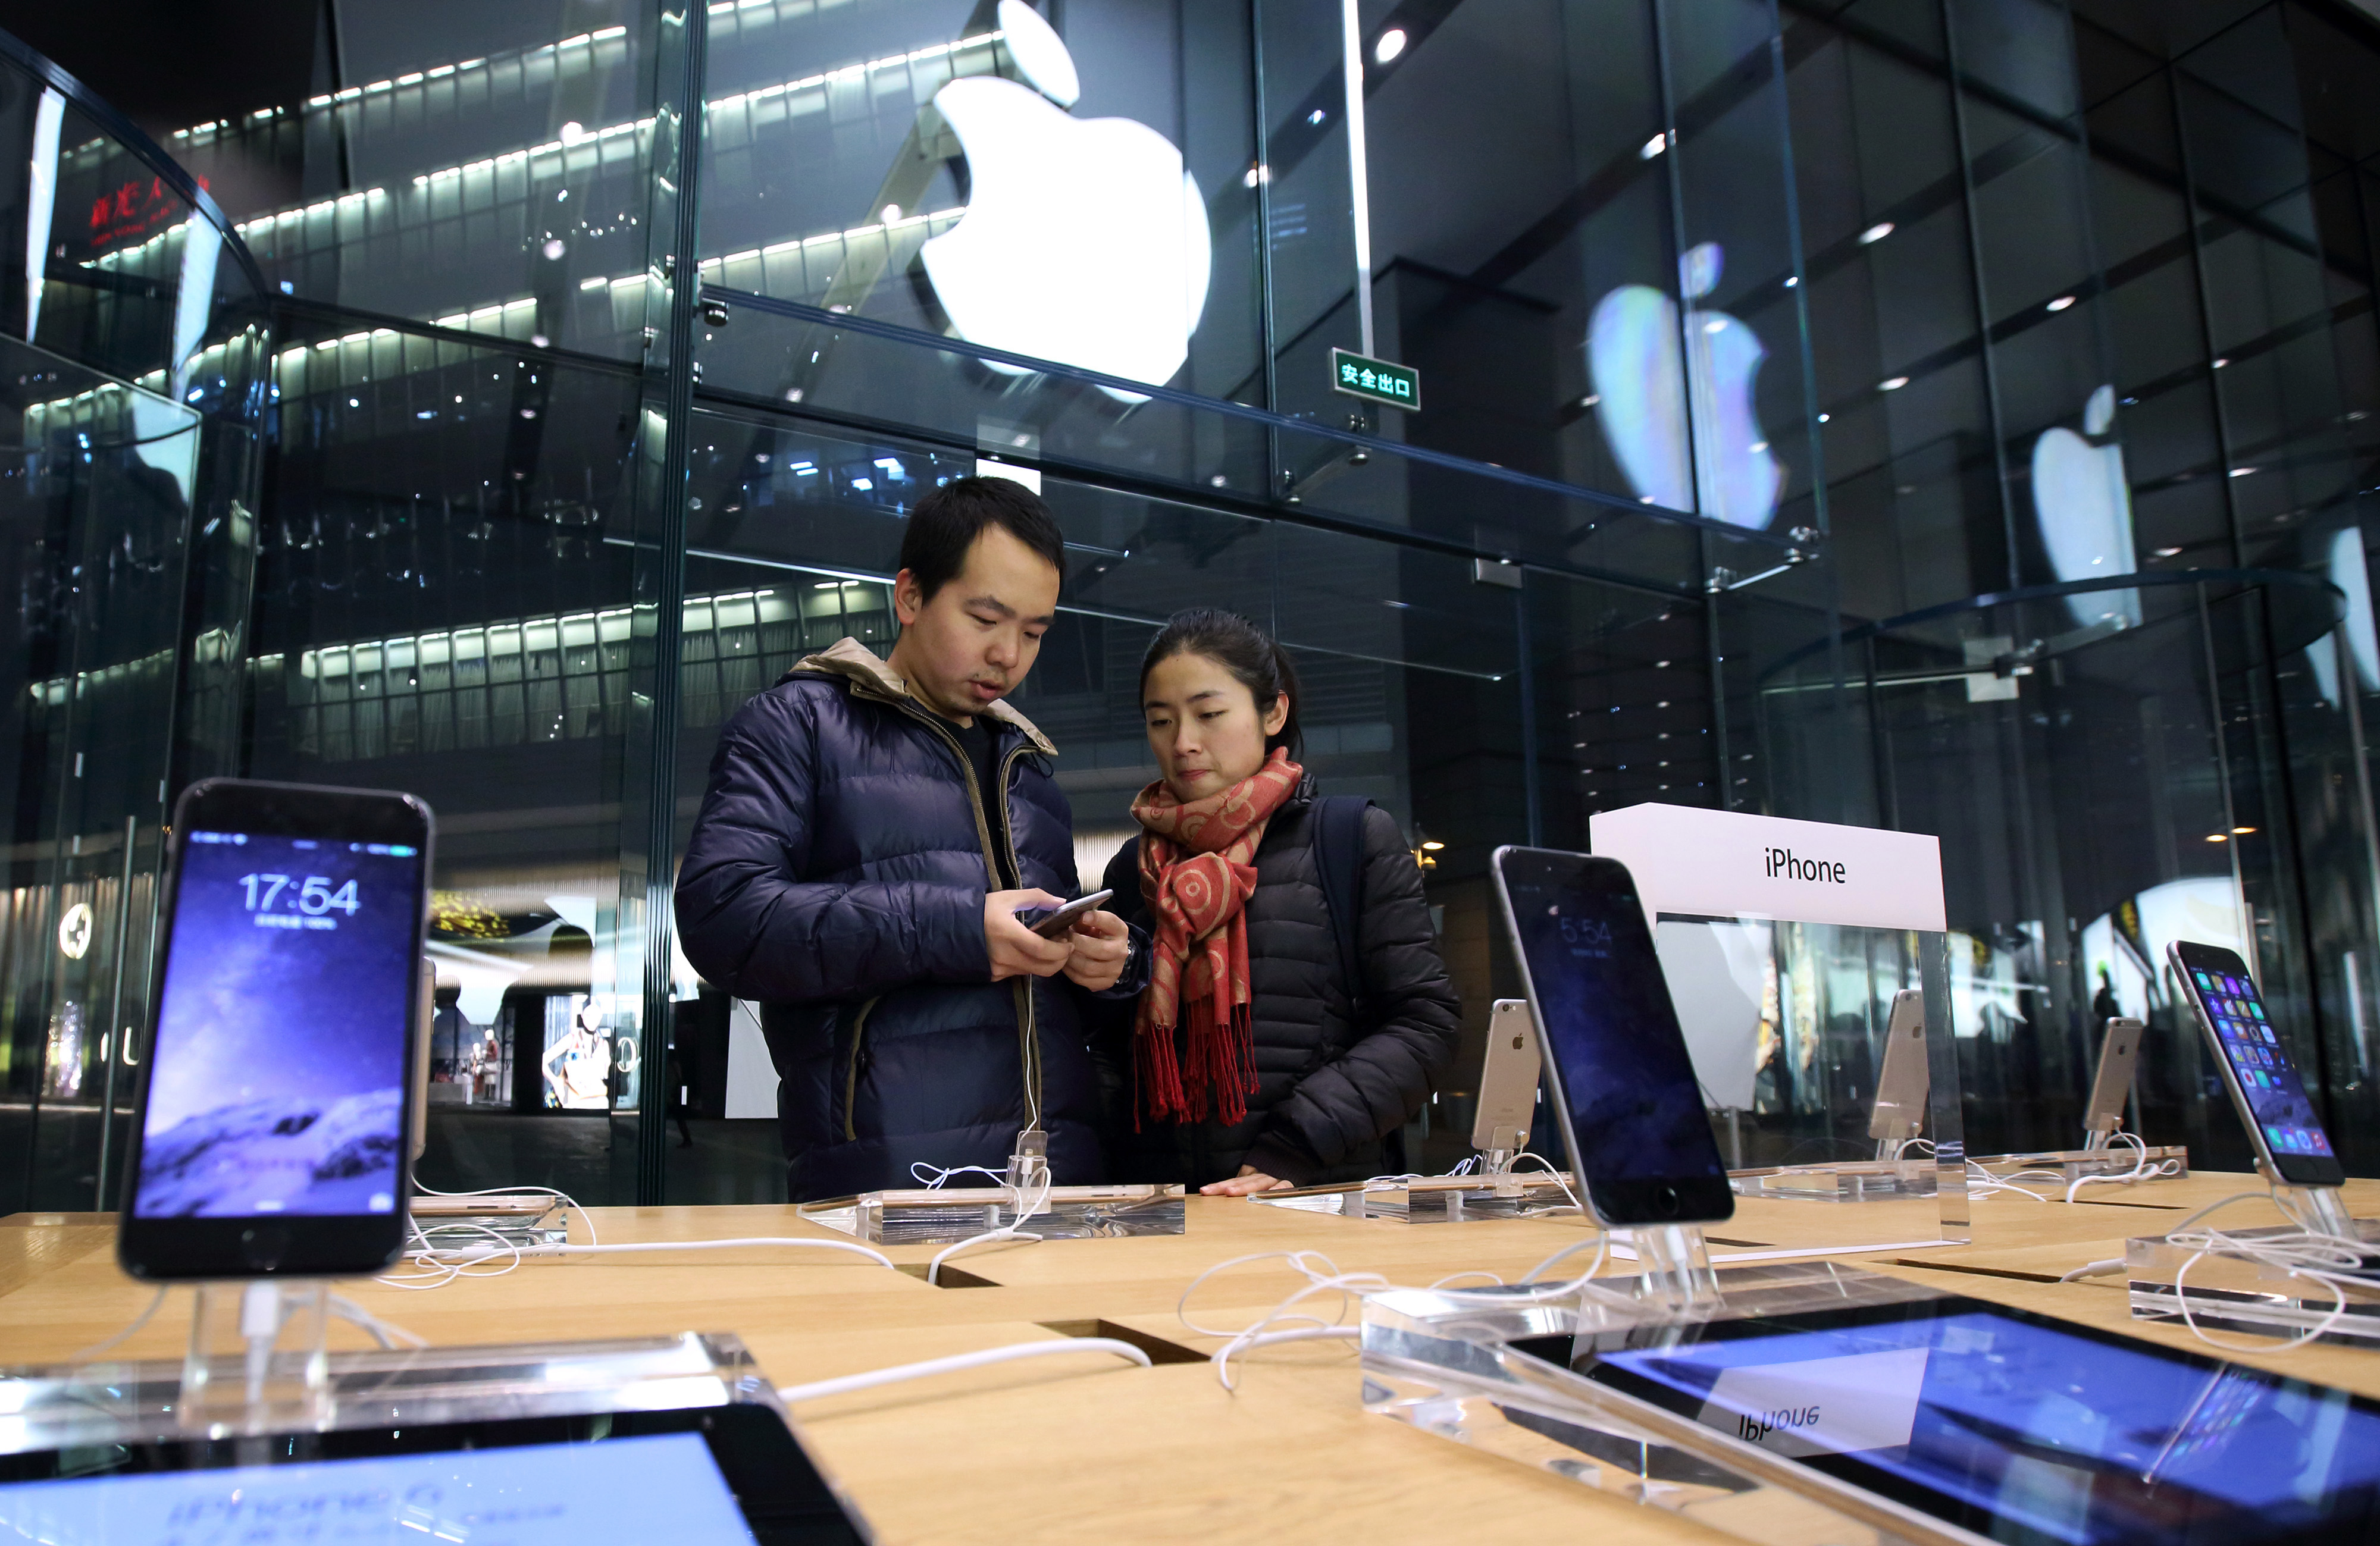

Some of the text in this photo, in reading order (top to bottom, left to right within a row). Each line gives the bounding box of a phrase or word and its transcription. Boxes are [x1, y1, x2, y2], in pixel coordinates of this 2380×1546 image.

[1342, 363, 1410, 397] 安全出口
[1765, 847, 1846, 883] iPhone
[239, 873, 362, 917] 17:54
